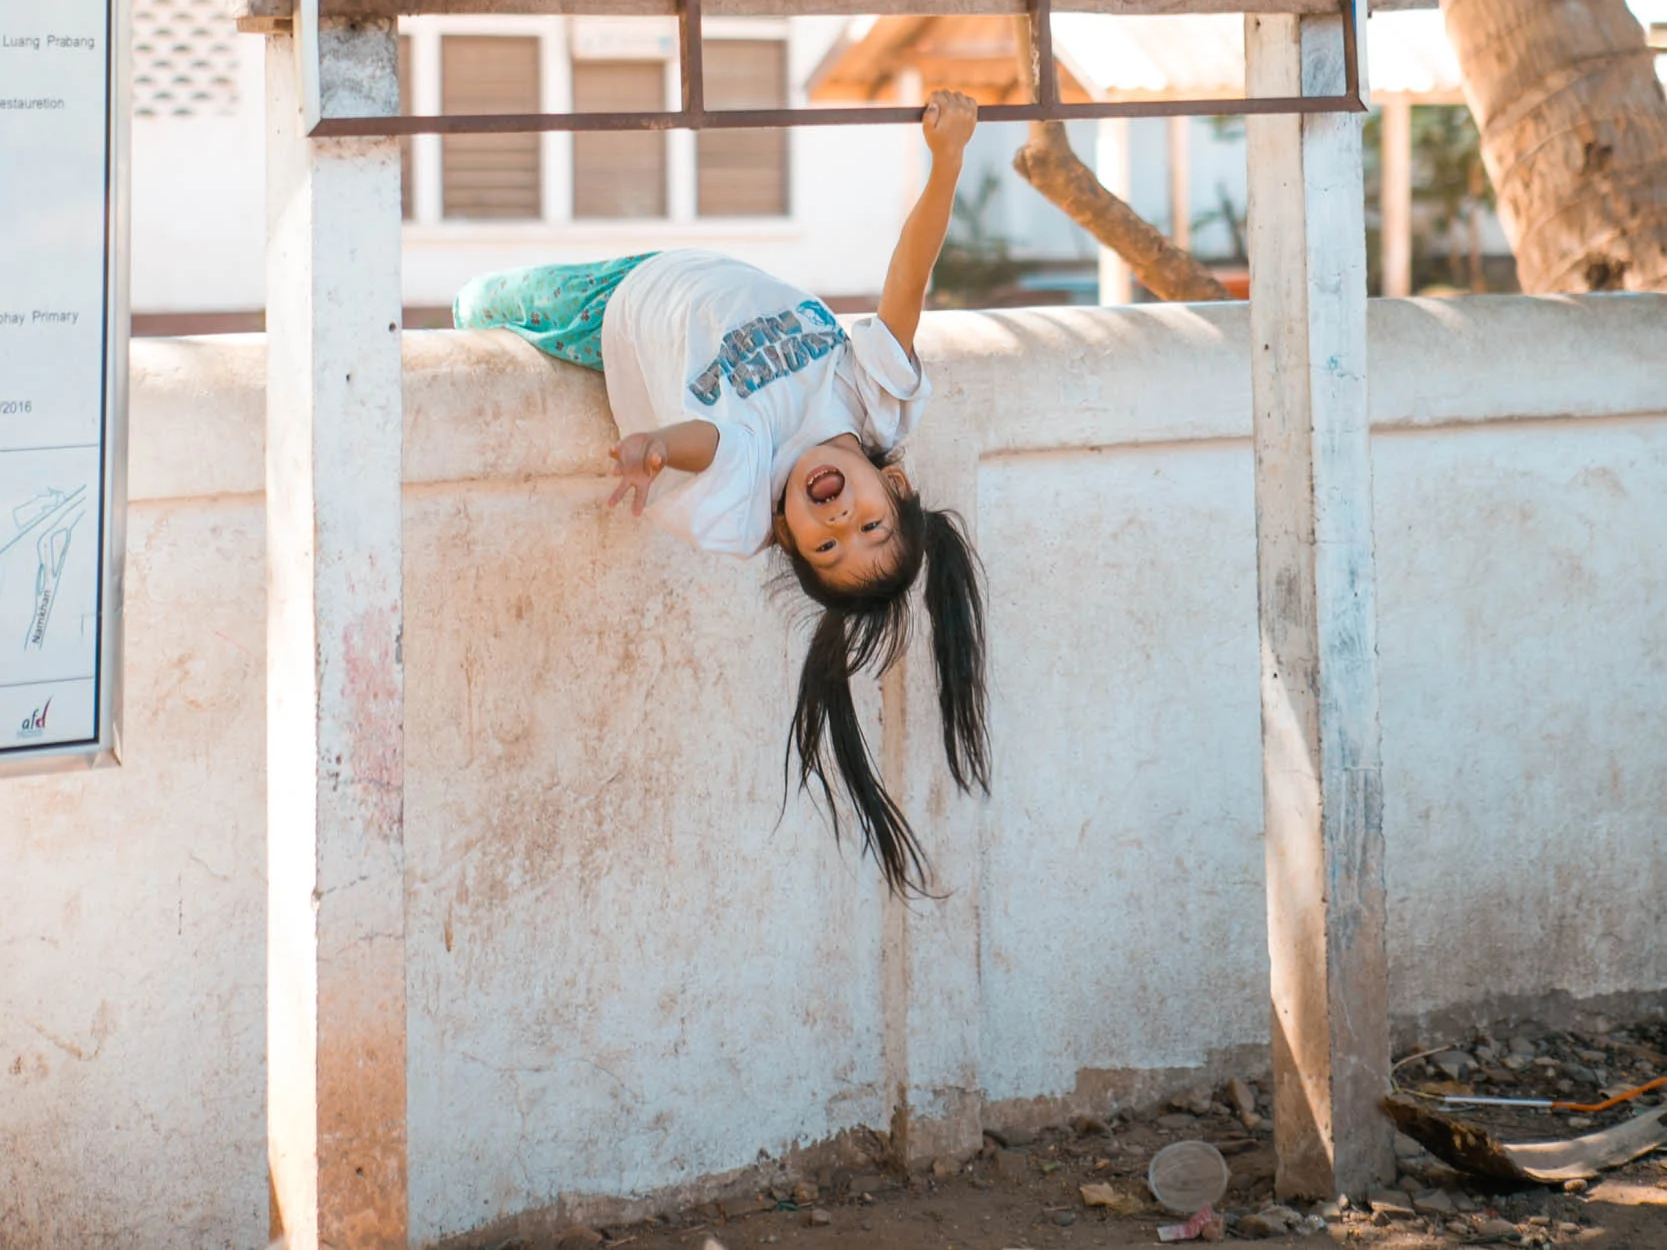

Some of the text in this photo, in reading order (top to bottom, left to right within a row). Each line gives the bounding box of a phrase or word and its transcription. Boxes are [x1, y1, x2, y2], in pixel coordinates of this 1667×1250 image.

[3, 34, 95, 51] Luang Prabang
[32, 310, 79, 325] Primary
[22, 695, 54, 730] afd
